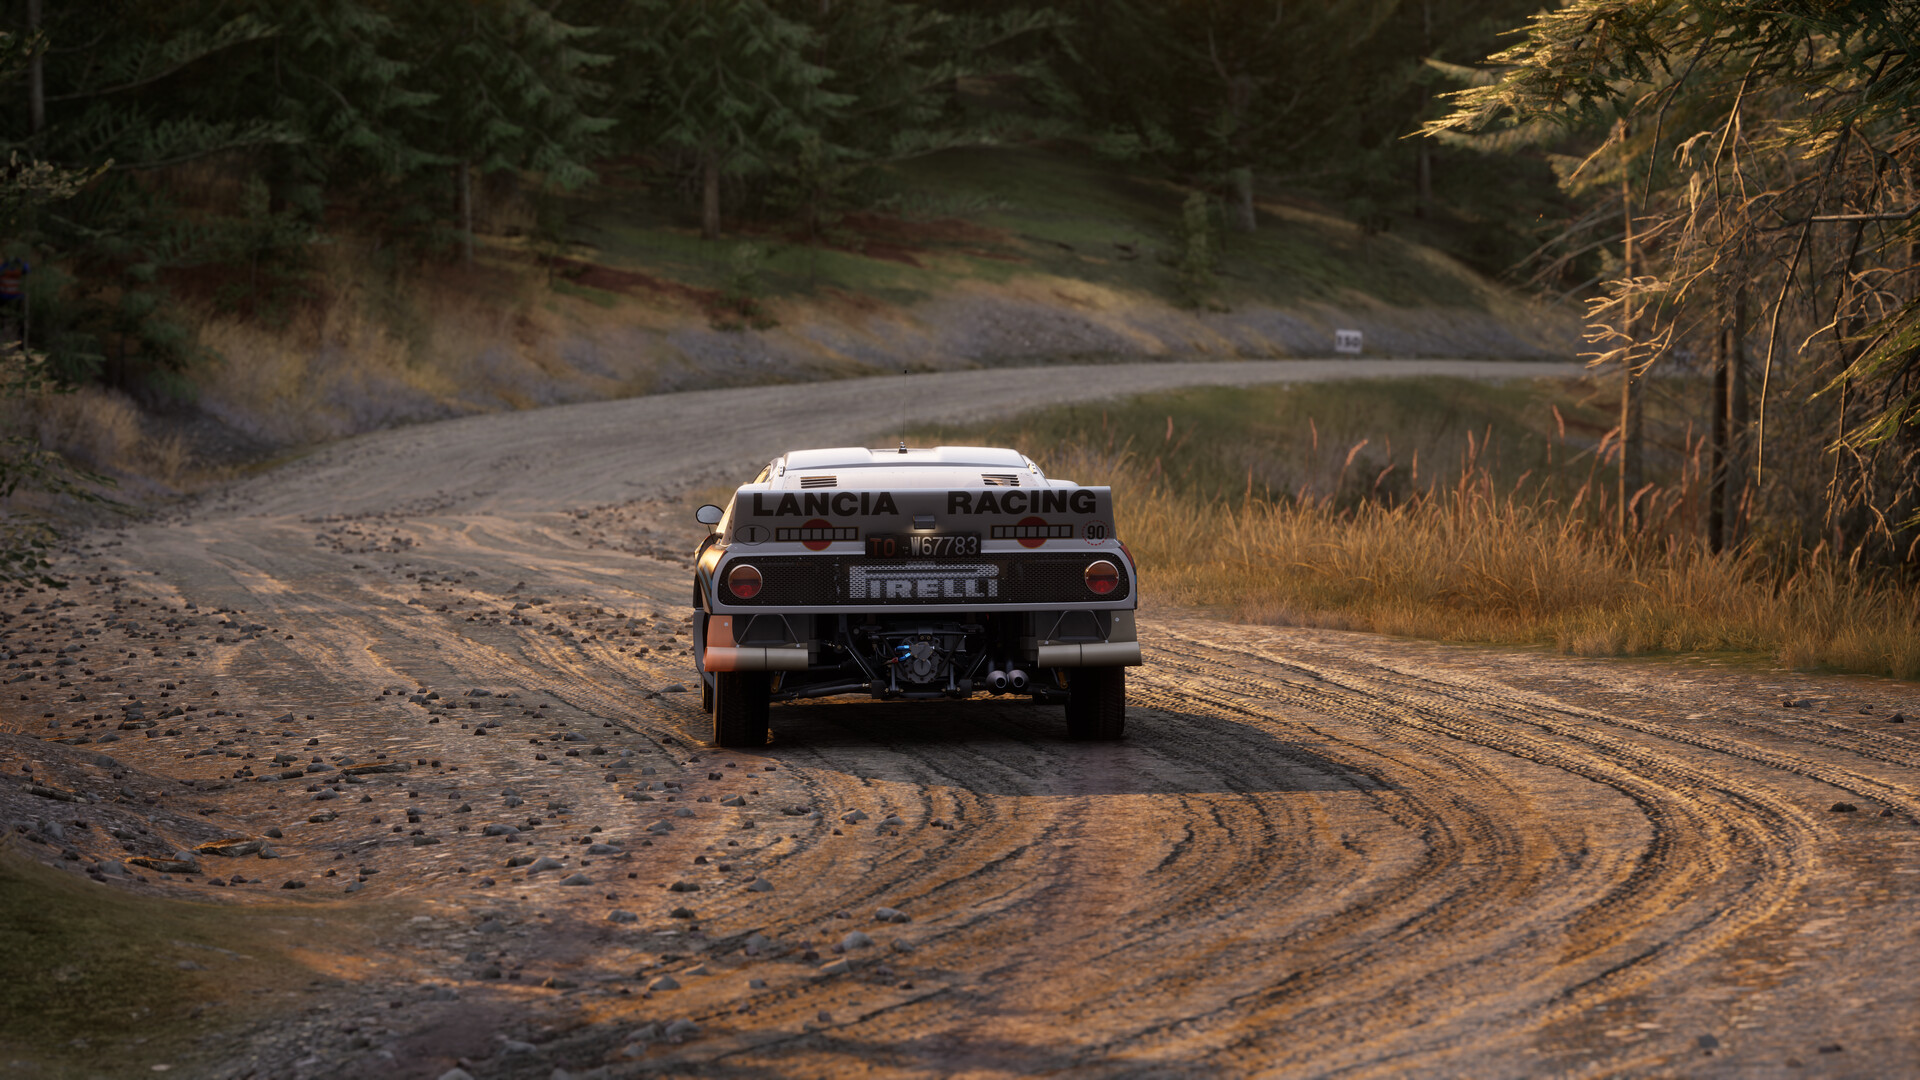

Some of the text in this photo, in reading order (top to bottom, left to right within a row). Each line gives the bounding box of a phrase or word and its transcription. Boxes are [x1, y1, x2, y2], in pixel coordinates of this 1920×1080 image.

[753, 489, 1096, 516] LANCIA RACING
[1087, 525, 1105, 540] 90
[870, 538, 896, 557] TO
[910, 536, 978, 556] W67783
[849, 563, 999, 598] PIRELLI
